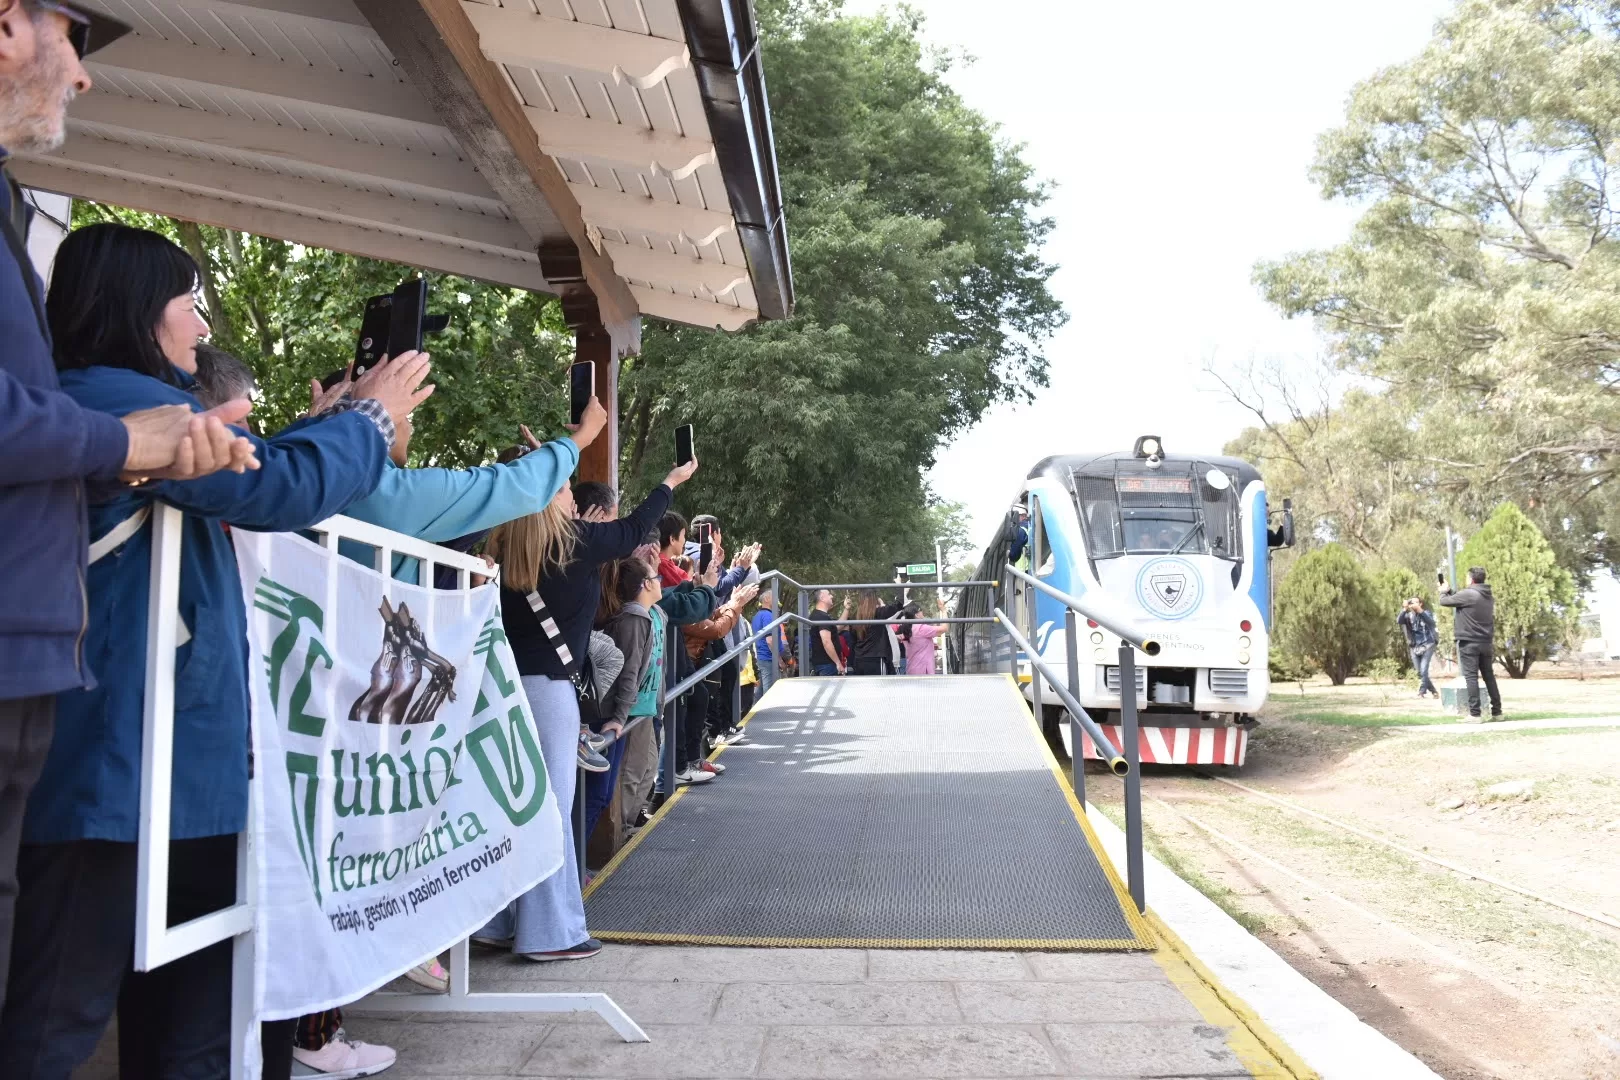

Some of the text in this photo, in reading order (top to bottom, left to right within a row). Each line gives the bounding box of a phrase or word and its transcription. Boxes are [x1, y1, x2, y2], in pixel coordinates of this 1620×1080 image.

[328, 811, 487, 892] ferroviaria
[328, 834, 512, 935] rabajo, gestión y pasión ferroviaria
